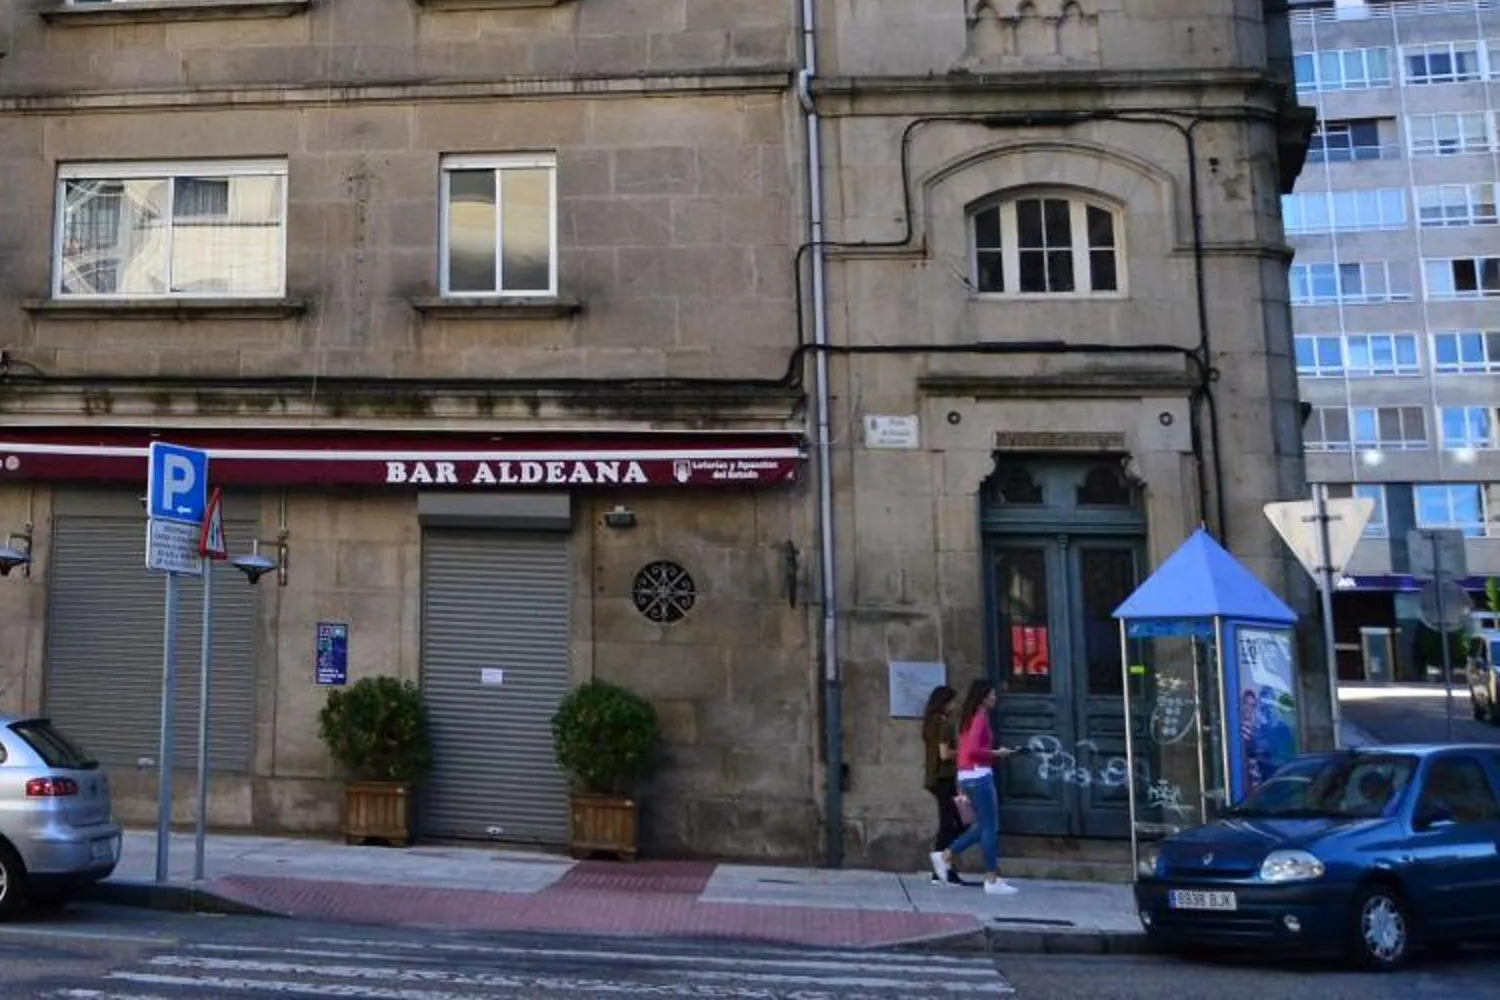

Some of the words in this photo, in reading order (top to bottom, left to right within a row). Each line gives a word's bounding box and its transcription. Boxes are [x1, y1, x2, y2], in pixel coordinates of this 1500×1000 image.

[162, 453, 196, 510] P
[386, 461, 458, 484] BAR
[472, 461, 649, 484] ALDEANA
